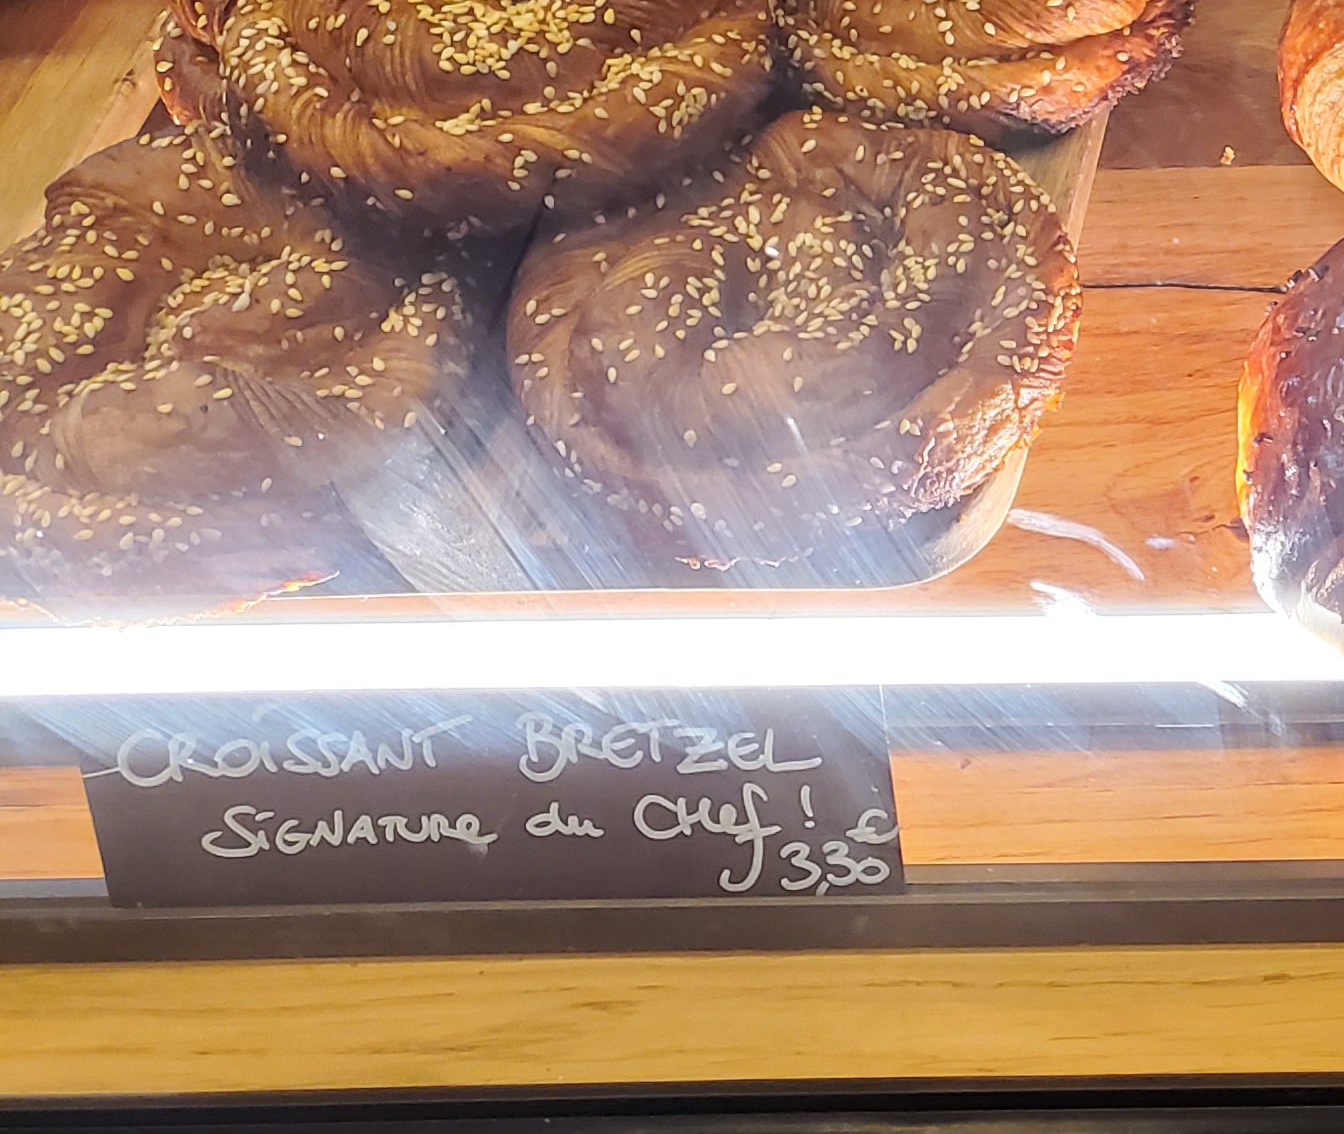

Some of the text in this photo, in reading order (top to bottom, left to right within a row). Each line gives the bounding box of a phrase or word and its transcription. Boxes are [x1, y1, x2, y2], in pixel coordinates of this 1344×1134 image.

[116, 703, 823, 788] CROISSANT BRETZEL
[524, 800, 605, 838] du
[779, 839, 892, 897] 3,30
